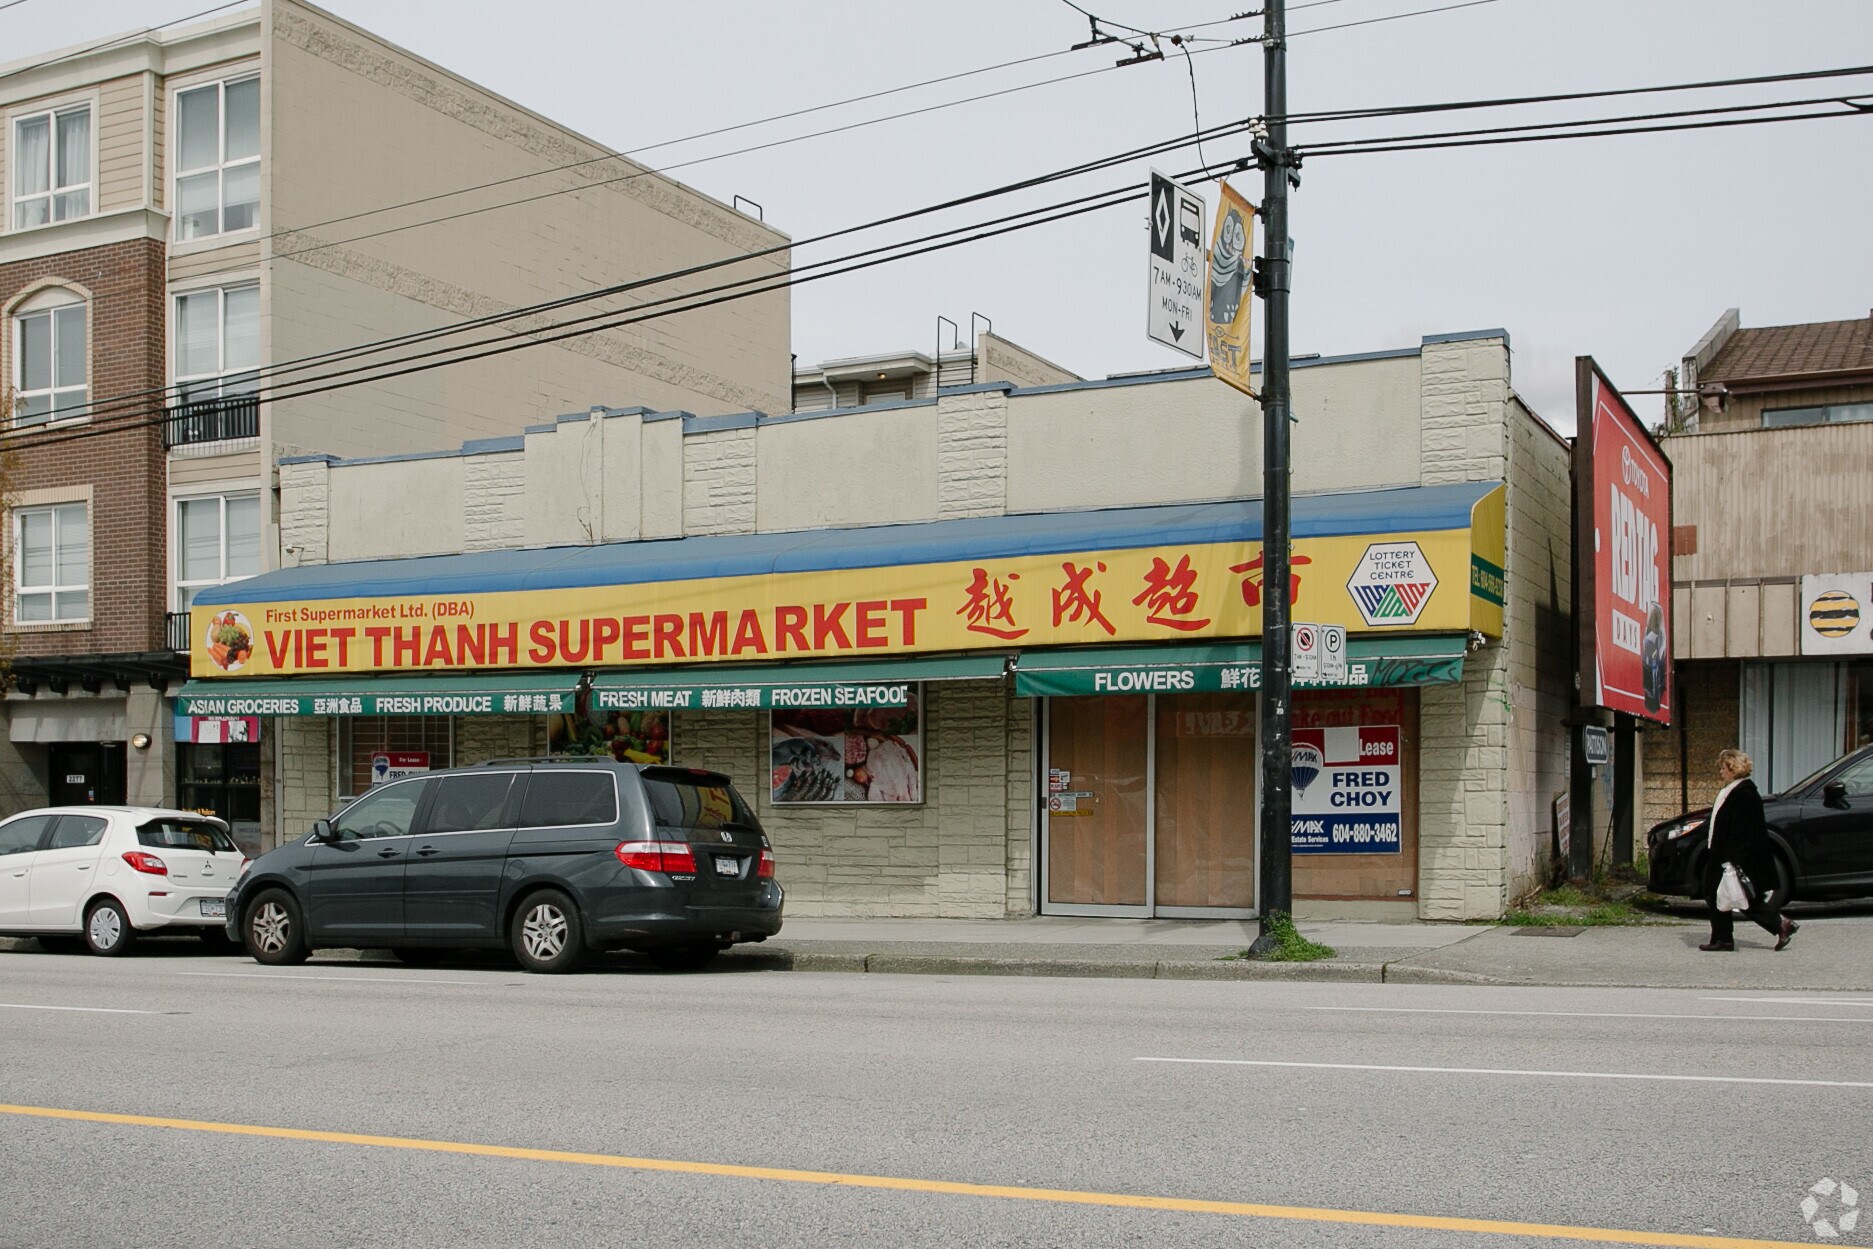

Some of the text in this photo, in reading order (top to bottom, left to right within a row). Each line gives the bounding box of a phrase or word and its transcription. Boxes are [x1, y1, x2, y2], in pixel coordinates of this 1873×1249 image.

[1162, 296, 1193, 321] MON-FRI
[1631, 459, 1650, 499] TOYOTA
[1369, 550, 1416, 560] LOTTERY
[1374, 560, 1411, 570] TICKET
[1370, 570, 1415, 580] CENTRE
[266, 600, 474, 624] First Supermarket Ltd. (DBA)
[264, 598, 927, 669] VIET THANH SUPERMARKET
[1616, 616, 1637, 648] DAYS
[1095, 670, 1195, 691] FLOWERS
[1220, 668, 1261, 689] 鮮花
[188, 698, 299, 714] ASIAN GROCERIES
[313, 697, 362, 714] 亞洲食品
[376, 696, 492, 713] FRESH PRODUCE
[504, 693, 563, 712] 新鮮蔬果
[600, 691, 692, 708] FRESH MEAT
[701, 689, 760, 707] 新鮮肉類
[772, 688, 831, 706] FROZEN
[1359, 738, 1394, 756] Lease
[1332, 771, 1390, 788] FRED
[1330, 791, 1392, 807] CHOY
[1307, 835, 1329, 843] Services
[1332, 823, 1397, 843] 604-880-3462
